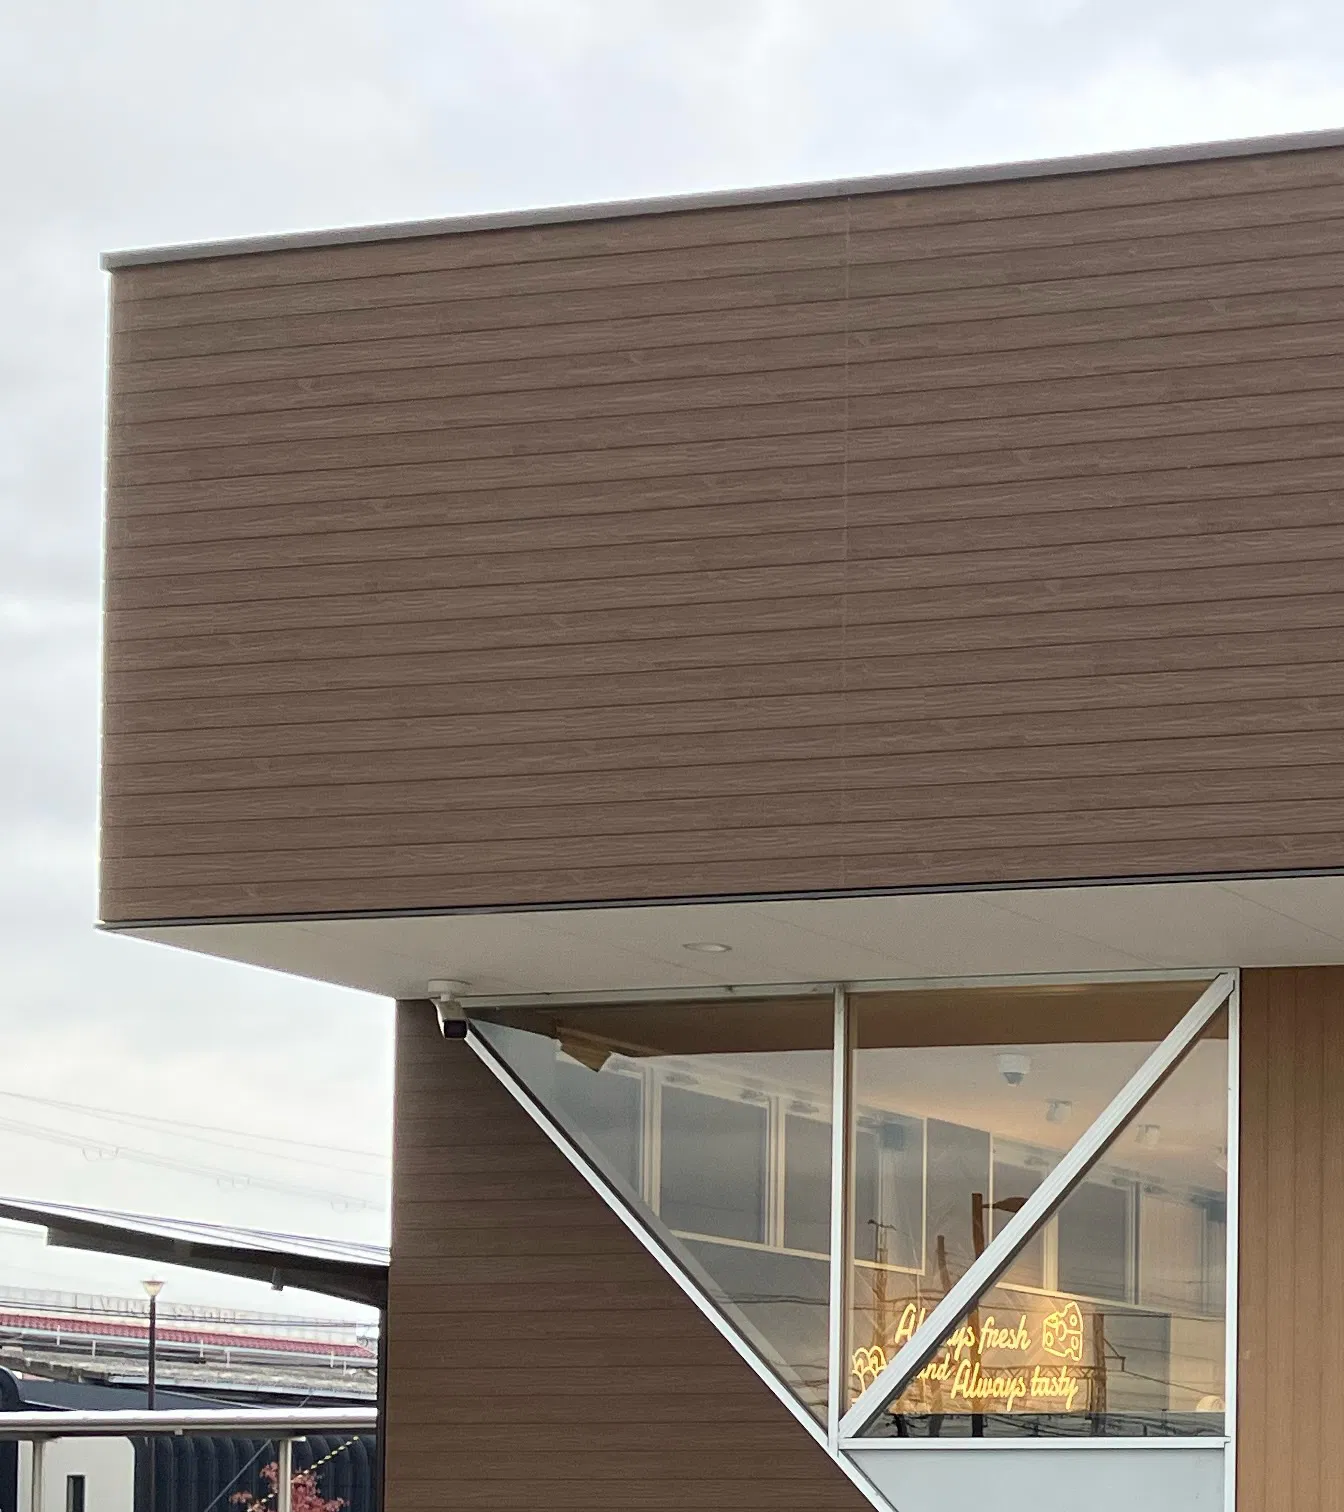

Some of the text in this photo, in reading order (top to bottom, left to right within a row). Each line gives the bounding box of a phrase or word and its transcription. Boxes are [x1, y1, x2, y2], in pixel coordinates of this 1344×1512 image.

[895, 1303, 1032, 1361] Alys fresh
[917, 1353, 1079, 1411] nd Always tasty
